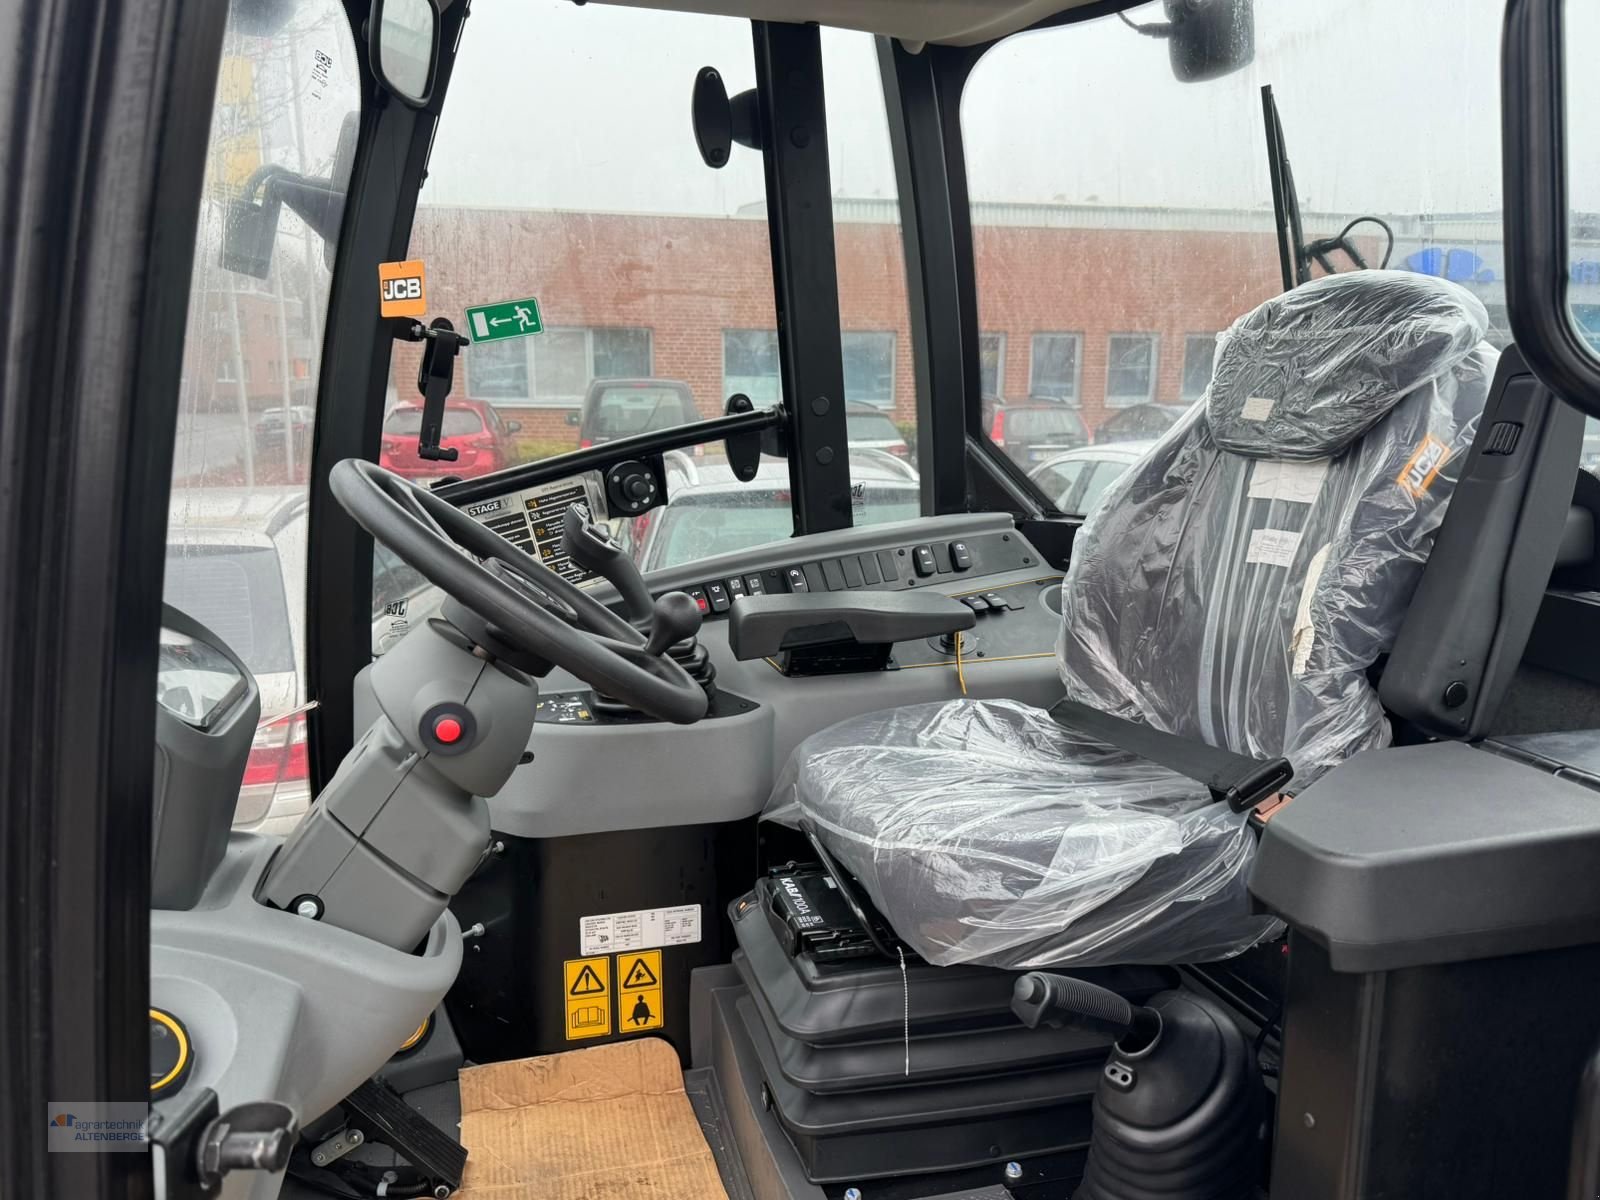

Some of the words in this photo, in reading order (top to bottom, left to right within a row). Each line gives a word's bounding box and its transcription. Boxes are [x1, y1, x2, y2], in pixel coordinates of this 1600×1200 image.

[383, 278, 421, 300] JCB
[1407, 441, 1443, 489] JCB
[470, 501, 500, 516] STAGE
